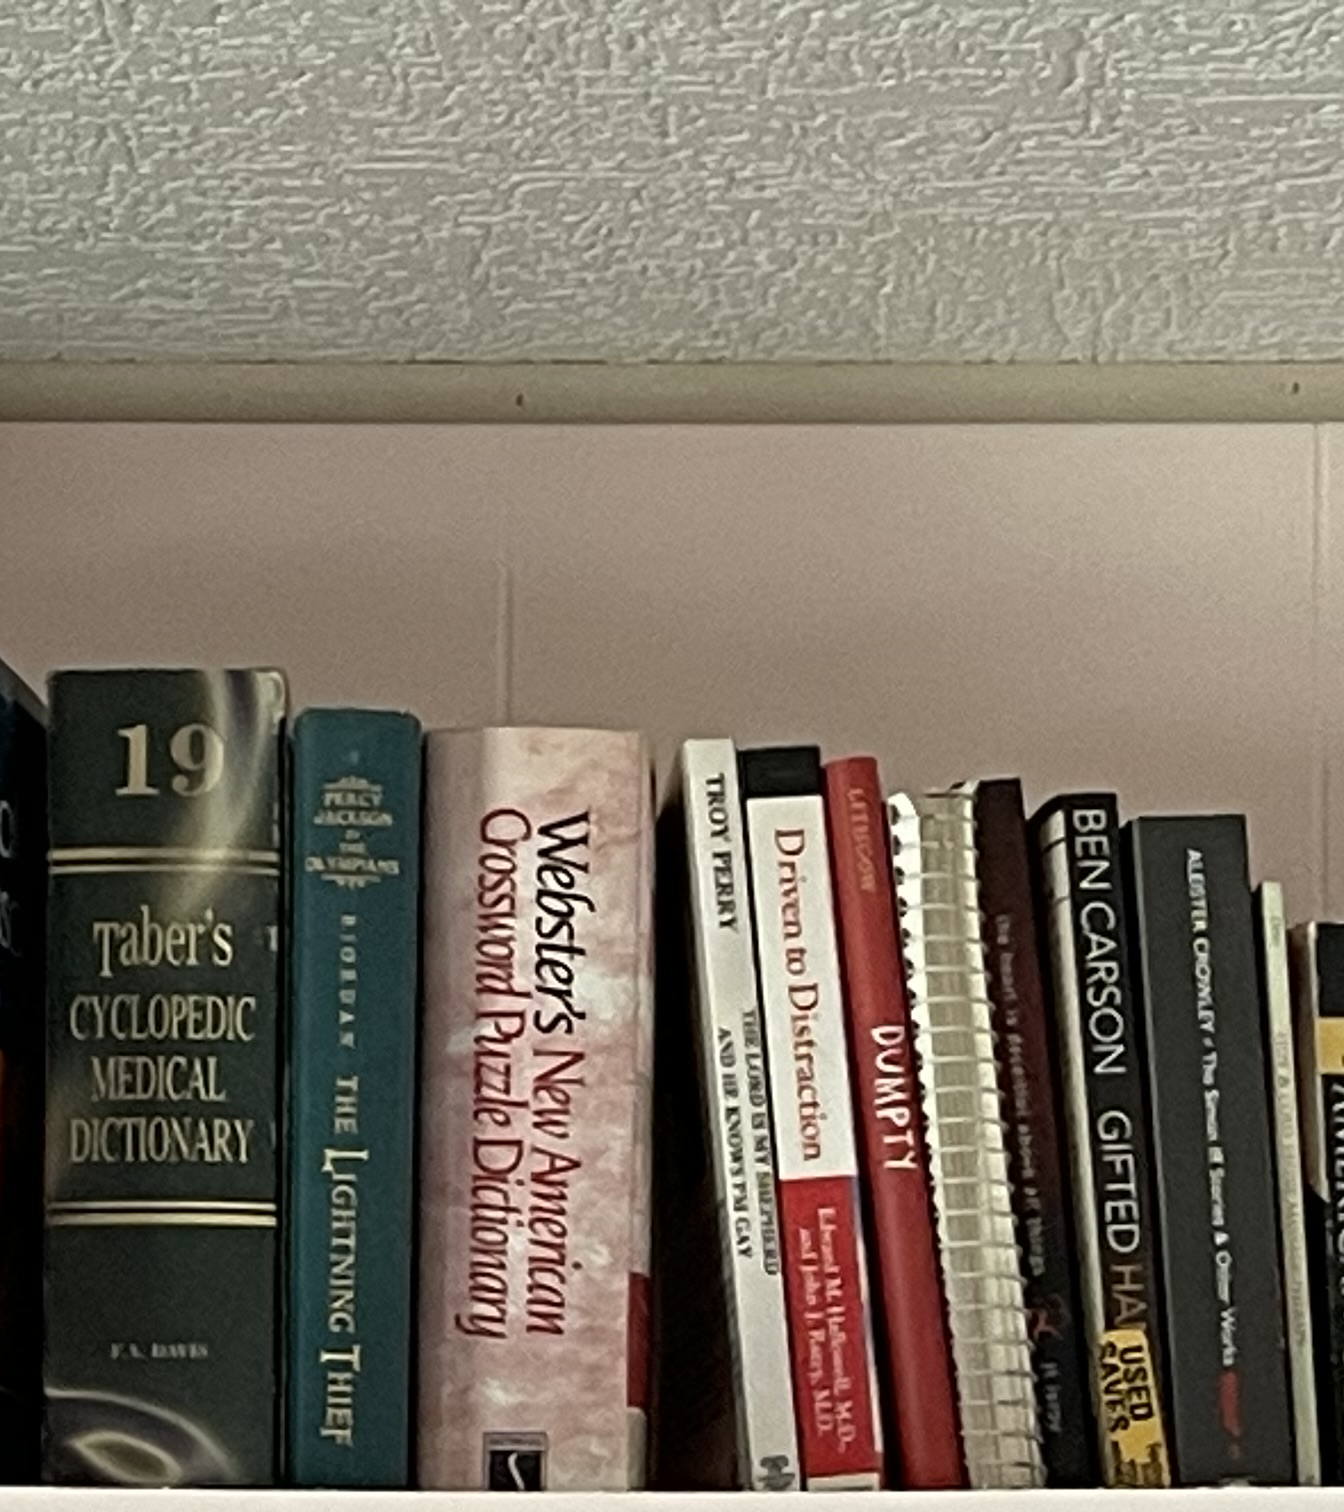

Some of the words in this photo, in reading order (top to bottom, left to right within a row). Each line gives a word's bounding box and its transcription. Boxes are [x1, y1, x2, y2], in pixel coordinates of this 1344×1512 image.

[115, 722, 225, 797] 19
[705, 772, 732, 844] TROY
[1072, 808, 1113, 892] BEN
[474, 807, 534, 999] Crossword
[534, 804, 597, 1036] Webster's
[711, 850, 739, 935] PERRY
[773, 827, 809, 940] Driven
[1185, 848, 1211, 934] ALEISTER
[92, 904, 234, 978] Taber's
[784, 947, 808, 977] to
[69, 993, 256, 1042] CYCLOPEDIC
[1079, 900, 1129, 1075] CARSON
[1191, 936, 1216, 1034] CROWLEY
[472, 1009, 530, 1128] Puzzle
[716, 1027, 737, 1069] AND
[742, 1008, 760, 1048] THE
[91, 1055, 227, 1102] MEDICAL
[333, 1071, 360, 1135] THE
[532, 1047, 587, 1140] New
[744, 1051, 766, 1107] LORD
[786, 982, 829, 1162] Distraction
[870, 1024, 919, 1170] DUMPTY
[69, 1116, 254, 1164] DICTIONARY
[724, 1106, 747, 1177] KNOWS
[1096, 1109, 1142, 1255] GIFTED
[320, 1147, 370, 1334] LIGHTNING
[455, 1136, 526, 1339] Dictionary
[525, 1145, 584, 1337] American
[734, 1217, 753, 1259] GAY
[1108, 1263, 1150, 1328] HA
[320, 1343, 362, 1447] THIEF
[1118, 1344, 1155, 1422] USED
